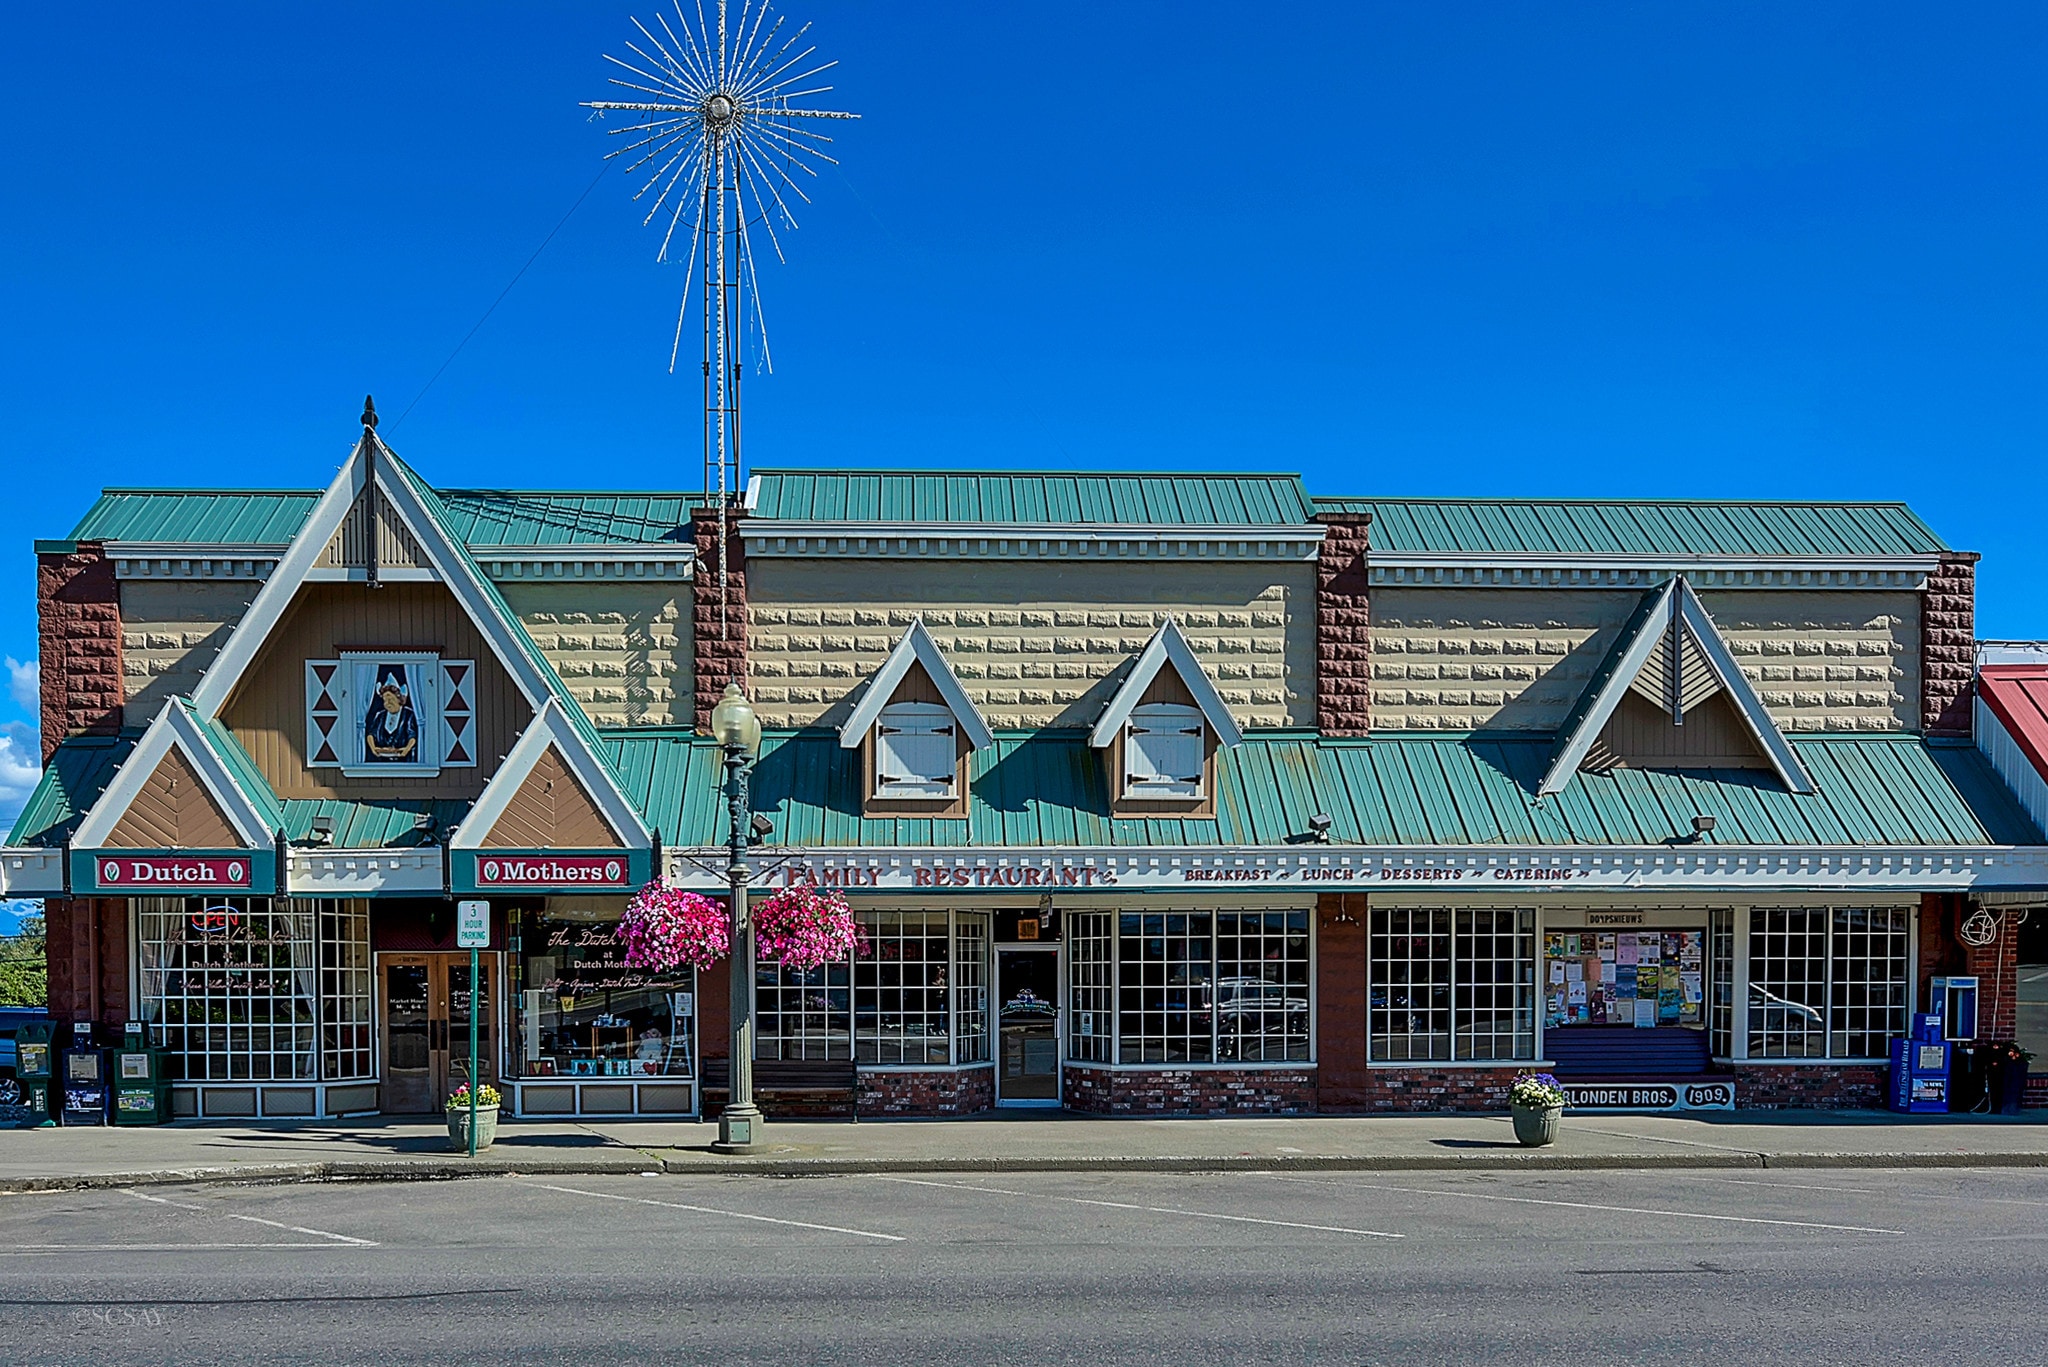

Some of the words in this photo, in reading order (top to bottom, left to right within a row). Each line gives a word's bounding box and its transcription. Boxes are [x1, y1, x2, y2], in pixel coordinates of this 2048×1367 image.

[131, 862, 217, 881] Dutch
[502, 862, 603, 880] Mothers
[786, 866, 884, 886] FAMILY
[914, 866, 1098, 886] RESTAURANT
[1184, 869, 1271, 882] BREAKFAST
[1301, 868, 1354, 881] LUNCH
[1381, 868, 1462, 881] DESSERTS
[1494, 868, 1573, 880] CATERING
[191, 911, 239, 926] OPEN
[470, 908, 477, 917] 3
[464, 920, 483, 928] HOUR
[461, 931, 486, 940] PARKING
[548, 927, 571, 947] The
[575, 927, 618, 947] Dutch
[603, 951, 613, 959] at
[574, 960, 601, 969] Dutch
[1633, 1090, 1673, 1104] BROS.
[1689, 1088, 1727, 1103] 1909.
